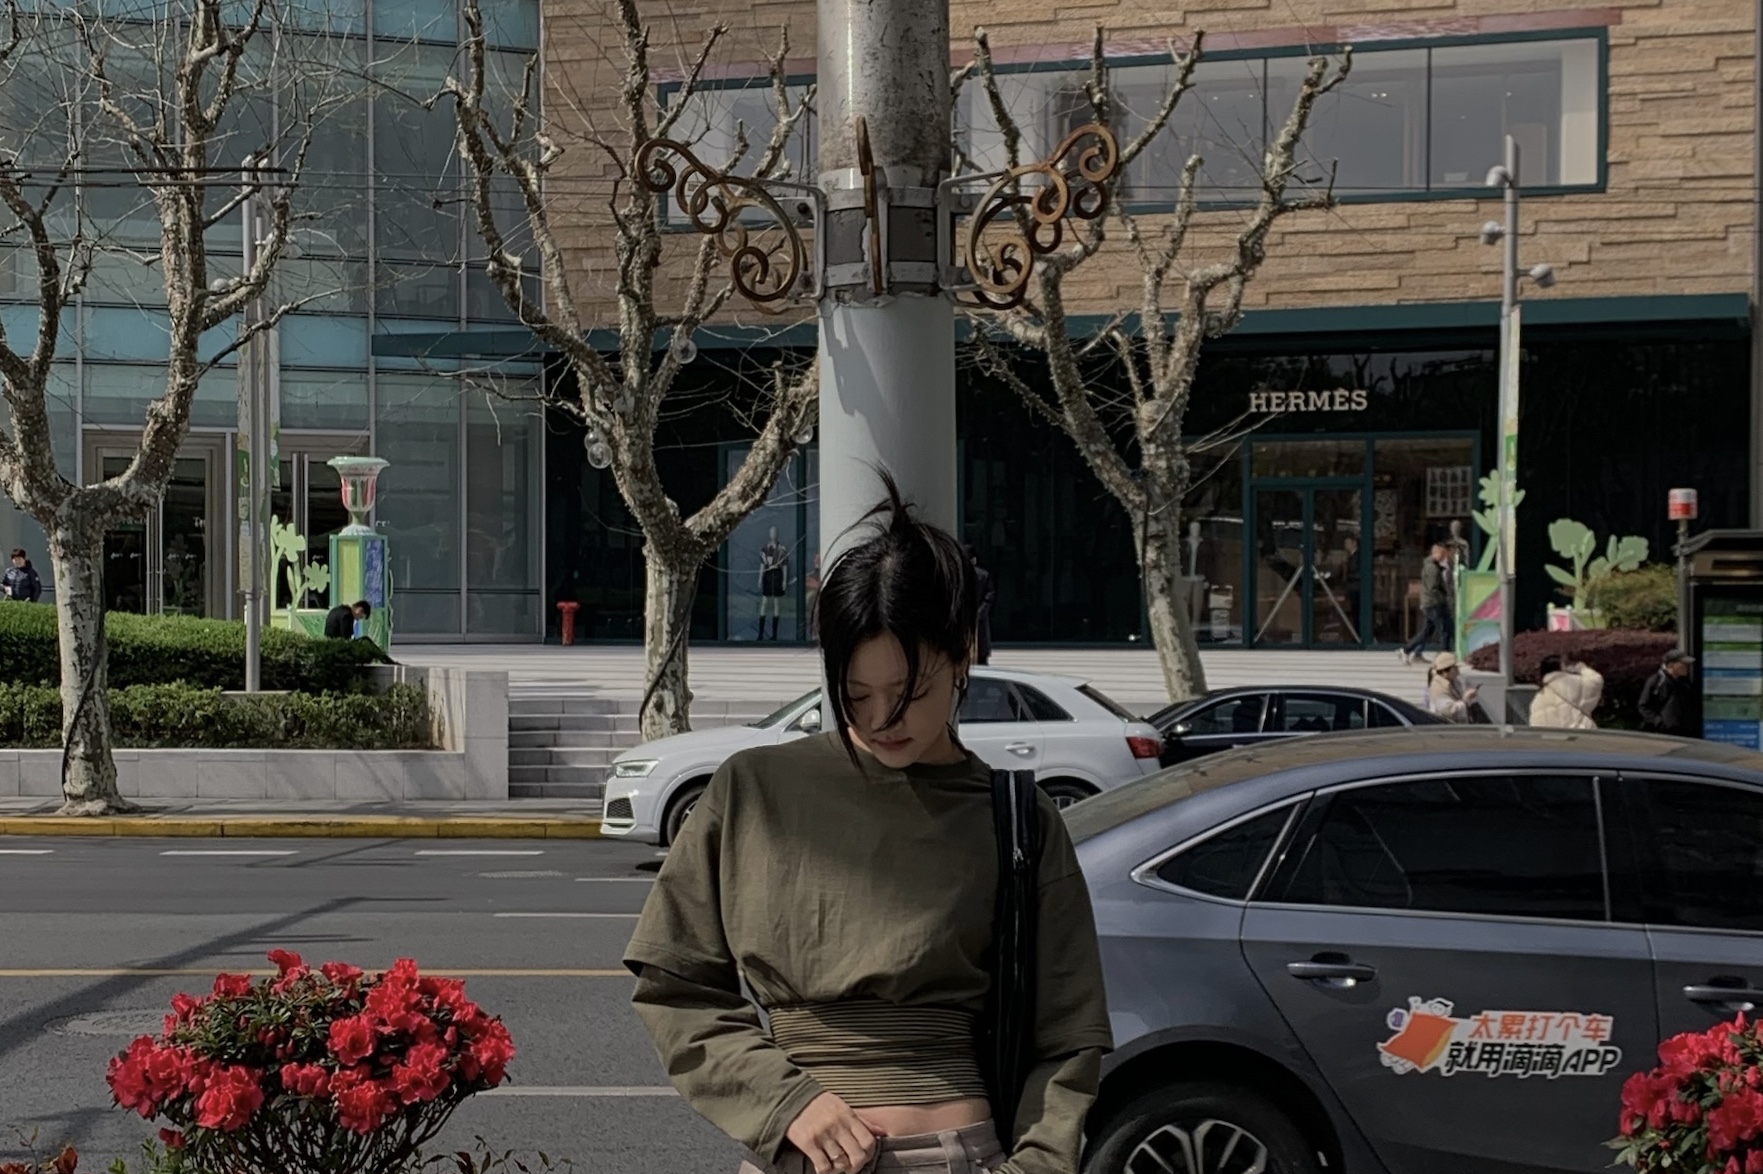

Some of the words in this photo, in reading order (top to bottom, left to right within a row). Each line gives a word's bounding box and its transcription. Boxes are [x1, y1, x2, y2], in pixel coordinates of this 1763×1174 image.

[1249, 388, 1368, 412] HERMÈS
[1468, 1014, 1611, 1041] 太累打个车
[1445, 1041, 1619, 1077] 就用滴滴APP
